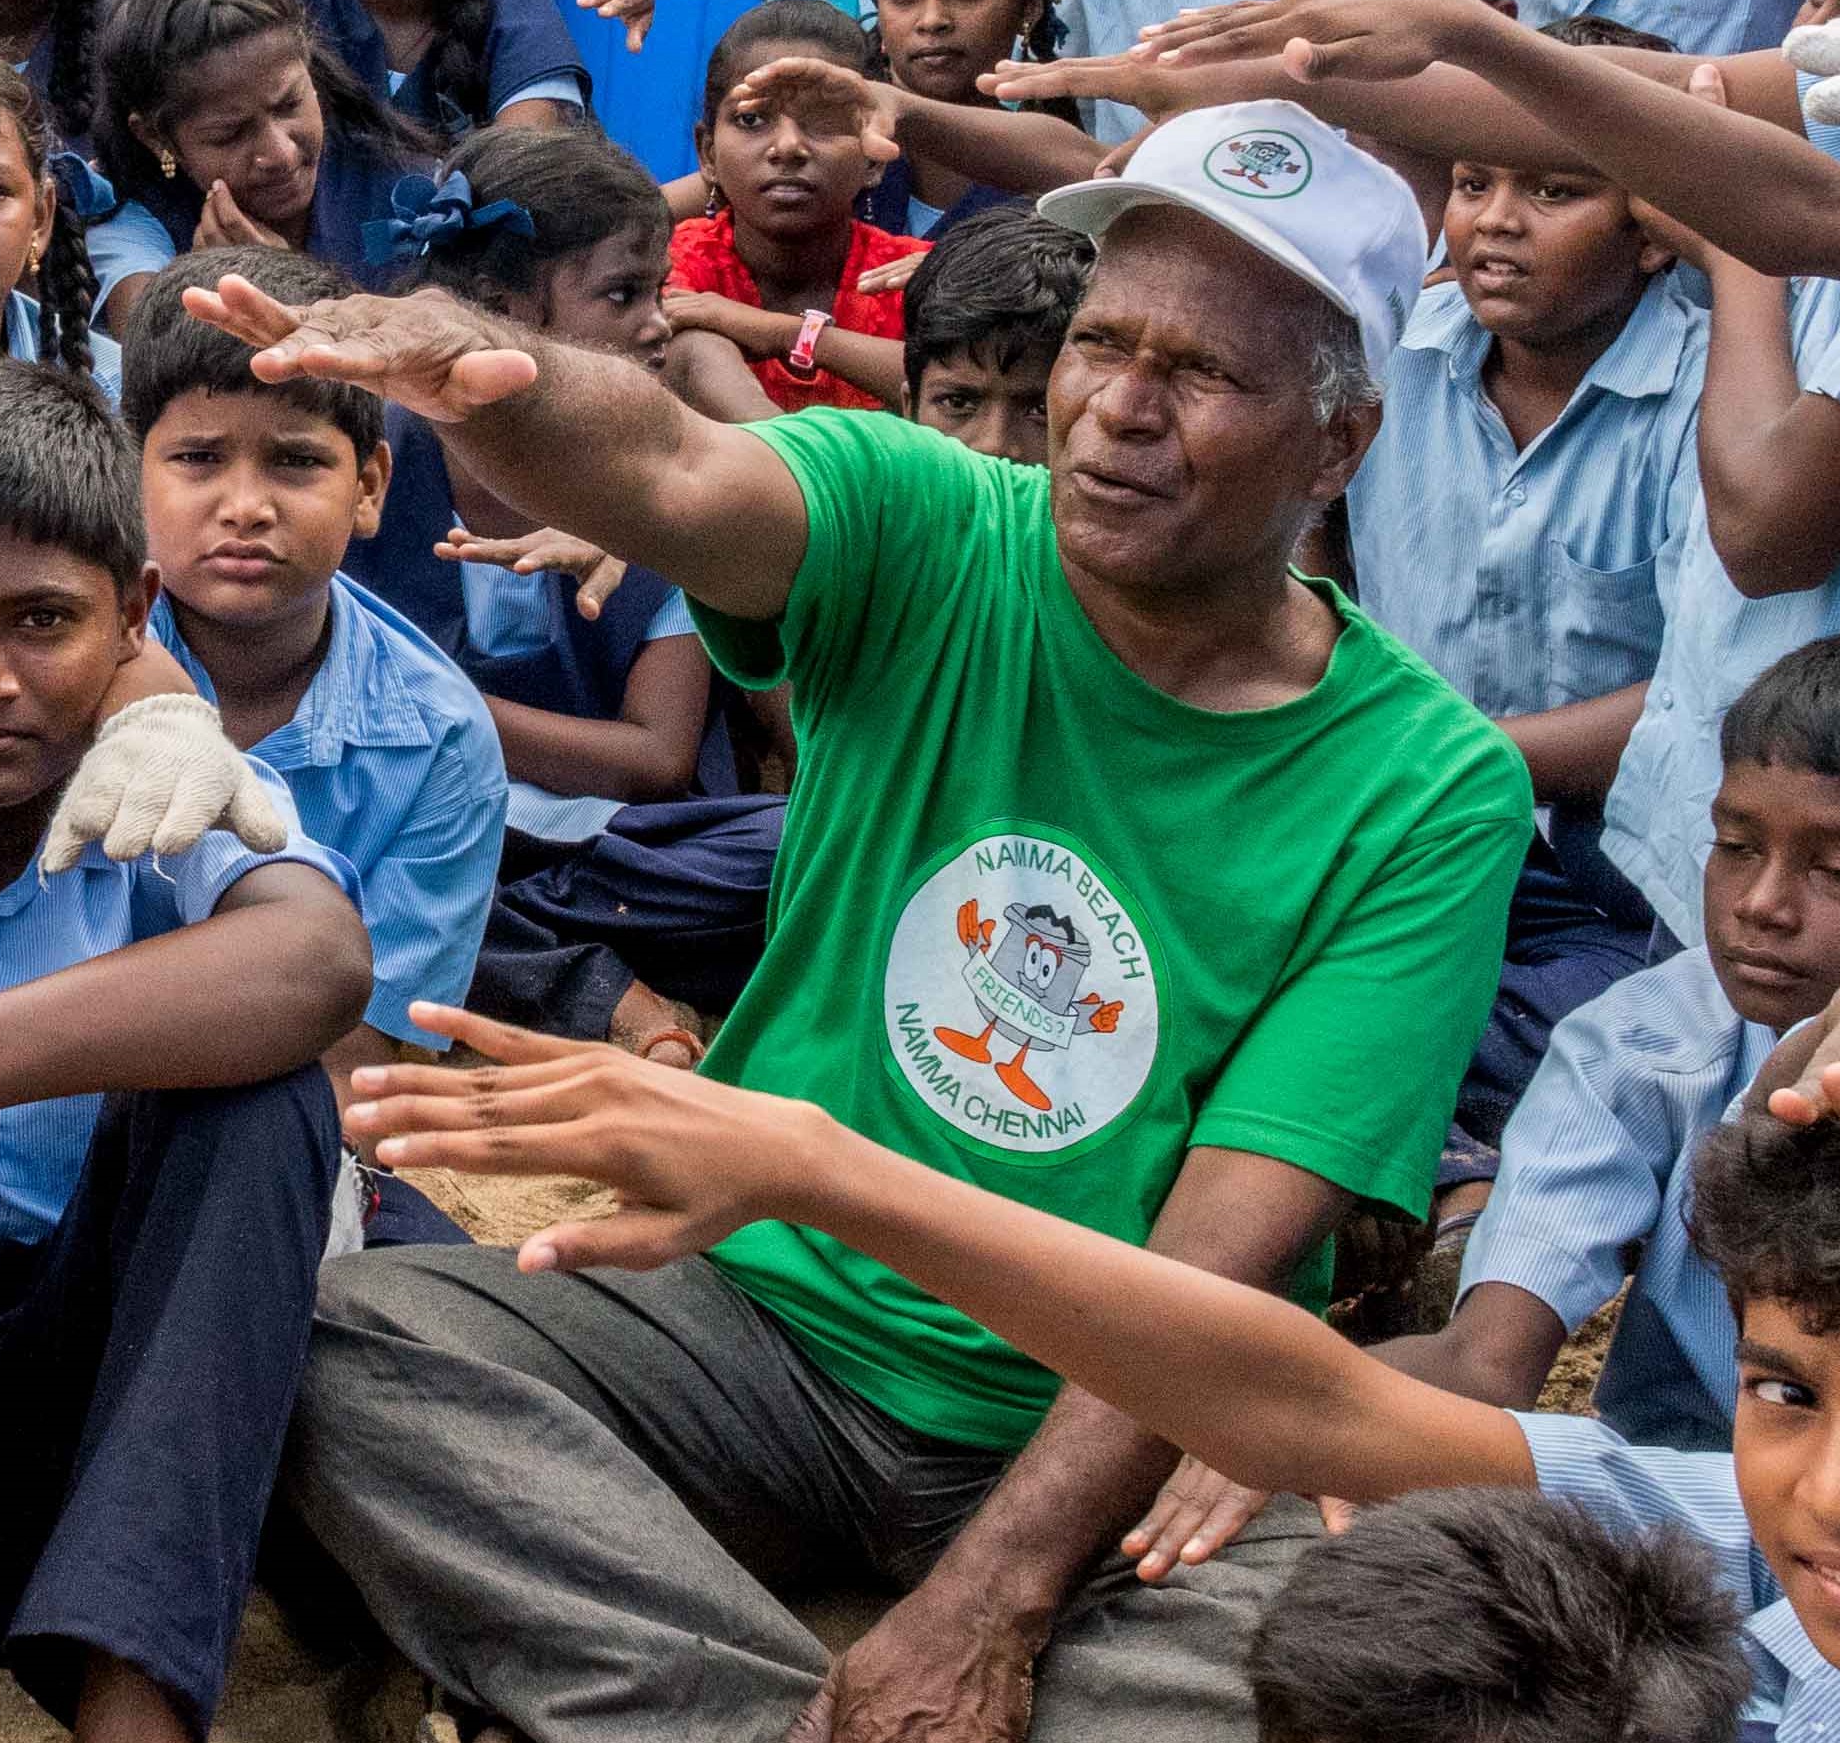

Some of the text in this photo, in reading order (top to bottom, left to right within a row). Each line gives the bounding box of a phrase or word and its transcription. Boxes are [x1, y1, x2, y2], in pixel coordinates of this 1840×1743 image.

[1075, 869, 1146, 981] BEACH
[971, 965, 1066, 1040] FRIENDS?
[895, 1001, 1086, 1139] NAMMA CHENNAI
